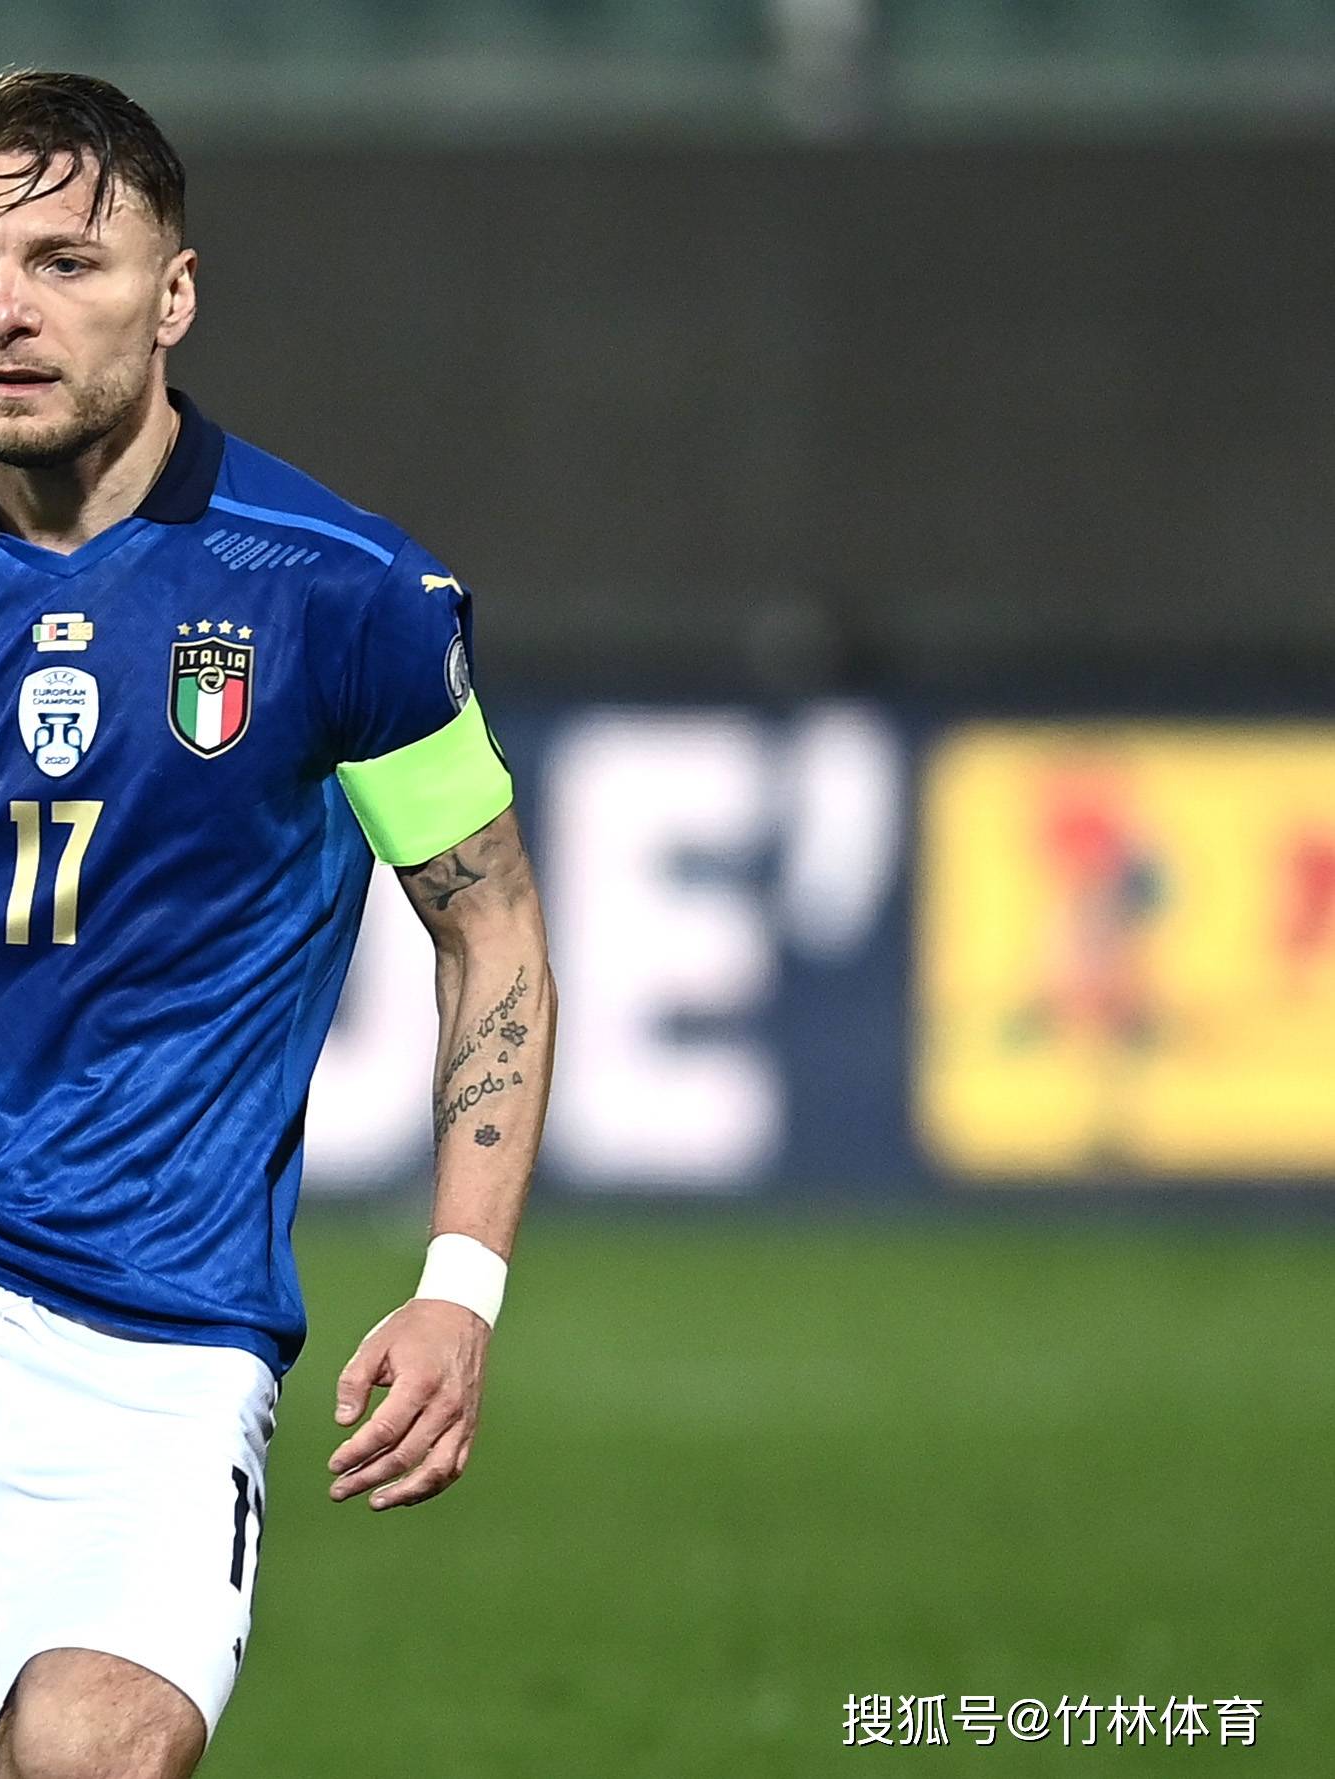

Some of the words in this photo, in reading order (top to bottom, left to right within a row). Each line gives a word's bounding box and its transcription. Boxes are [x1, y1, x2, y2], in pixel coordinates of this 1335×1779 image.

[179, 649, 246, 669] ITALIA
[45, 672, 75, 685] UEFA
[33, 688, 86, 696] EUROPEAN
[33, 697, 86, 705] CHAMPIONS
[44, 756, 71, 765] 2020
[5, 800, 104, 945] 17
[229, 1464, 265, 1594] 1
